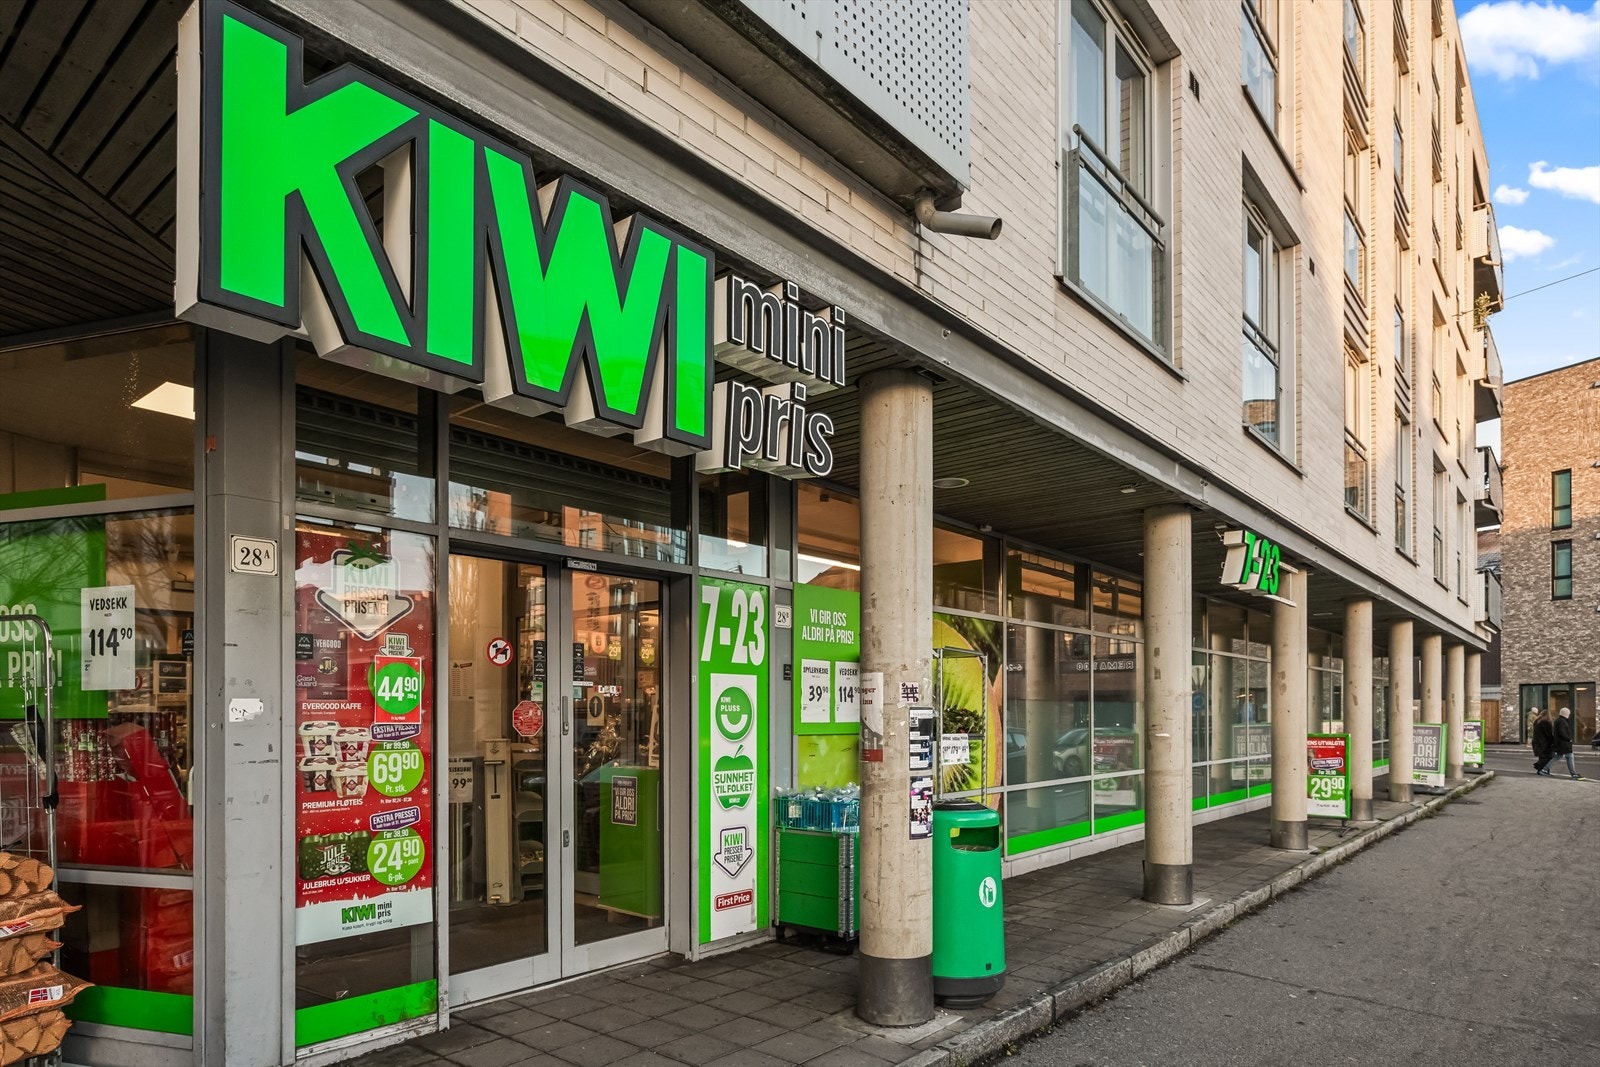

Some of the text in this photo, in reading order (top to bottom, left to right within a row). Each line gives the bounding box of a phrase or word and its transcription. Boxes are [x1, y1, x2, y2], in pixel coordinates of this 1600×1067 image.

[200, 2, 716, 450] KIWI
[731, 274, 846, 387] mini
[728, 380, 835, 477] pris
[1241, 530, 1280, 595] 7-23
[344, 585, 389, 601] PRESSER
[90, 597, 127, 611] VEDSEKK
[344, 600, 389, 615] PRISENE!
[810, 608, 847, 626] VI GIR OSS
[701, 584, 765, 666] 7-23
[388, 637, 405, 645] KIWI
[802, 625, 854, 645] ALDRI PÅ PRIS!
[302, 702, 362, 710] EVERGOOD KAFFE
[373, 725, 395, 734] EKSTRA
[1424, 736, 1438, 744] OSS
[714, 771, 754, 785] SUNNHET
[716, 782, 753, 794] TIL FOLKET
[302, 799, 363, 809] PREMIUM FLØTEIS
[615, 796, 635, 811] ALDRI
[373, 809, 417, 825] EKSTRA PRESSET
[724, 833, 743, 847] KIWI
[320, 843, 347, 865] JULE
[724, 845, 743, 855] PRESSER
[724, 853, 743, 863] PRISENE!
[302, 875, 371, 890] JULEBRUS U/SUKKER
[388, 872, 405, 882] 6-pk.
[377, 900, 392, 910] mini
[718, 893, 750, 907] First Price
[341, 903, 377, 924] KIWI
[377, 909, 391, 920] pris
